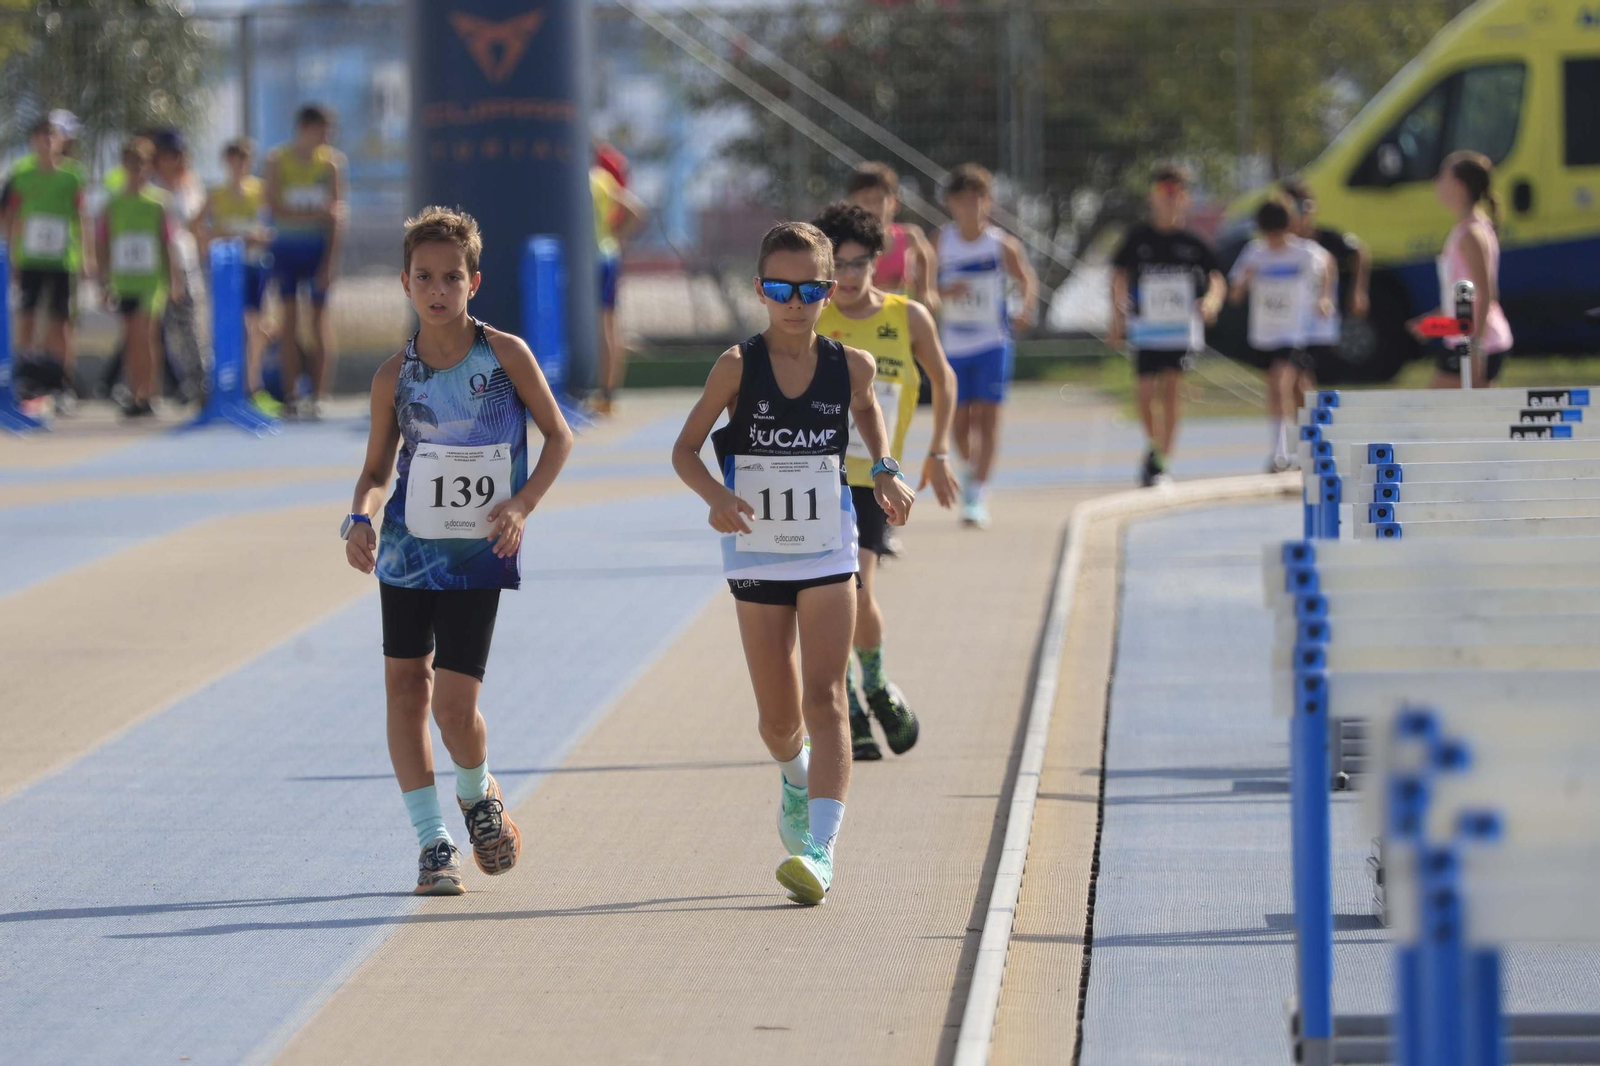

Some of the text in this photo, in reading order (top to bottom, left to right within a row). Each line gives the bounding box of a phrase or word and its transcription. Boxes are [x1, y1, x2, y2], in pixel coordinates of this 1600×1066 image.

[430, 476, 495, 508] 139
[758, 487, 820, 521] 111
[450, 519, 476, 528] docunova
[779, 533, 805, 541] docunova
